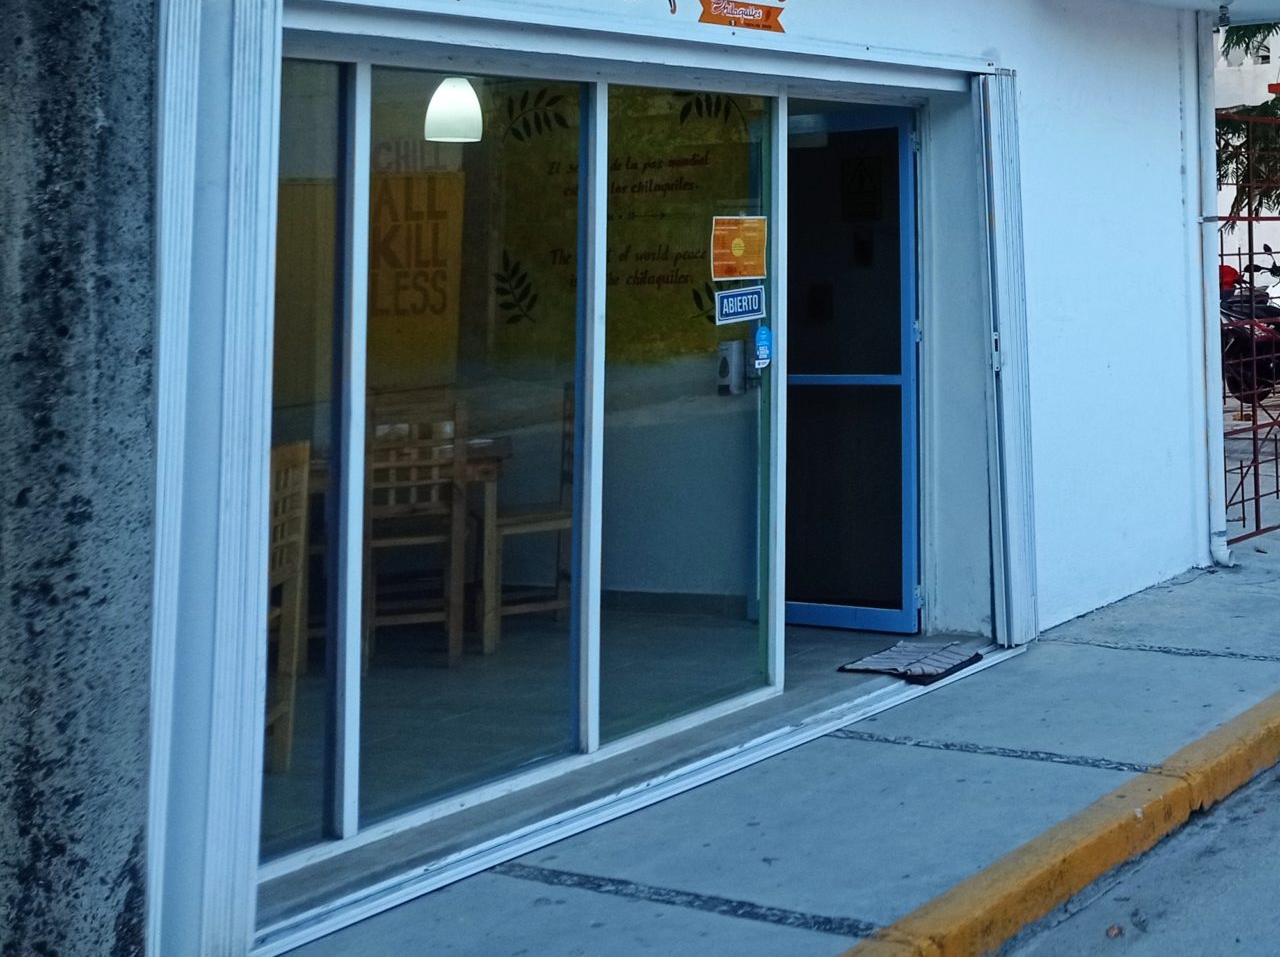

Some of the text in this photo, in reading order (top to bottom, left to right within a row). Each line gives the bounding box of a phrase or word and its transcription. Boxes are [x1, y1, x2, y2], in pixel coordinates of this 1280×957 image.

[710, 0, 763, 23] Chilaquiles
[372, 176, 448, 223] ALL
[371, 223, 448, 270] KILL
[550, 247, 572, 266] The
[635, 244, 669, 261] world
[371, 270, 447, 317] LESS
[722, 294, 759, 316] ABIERTO
